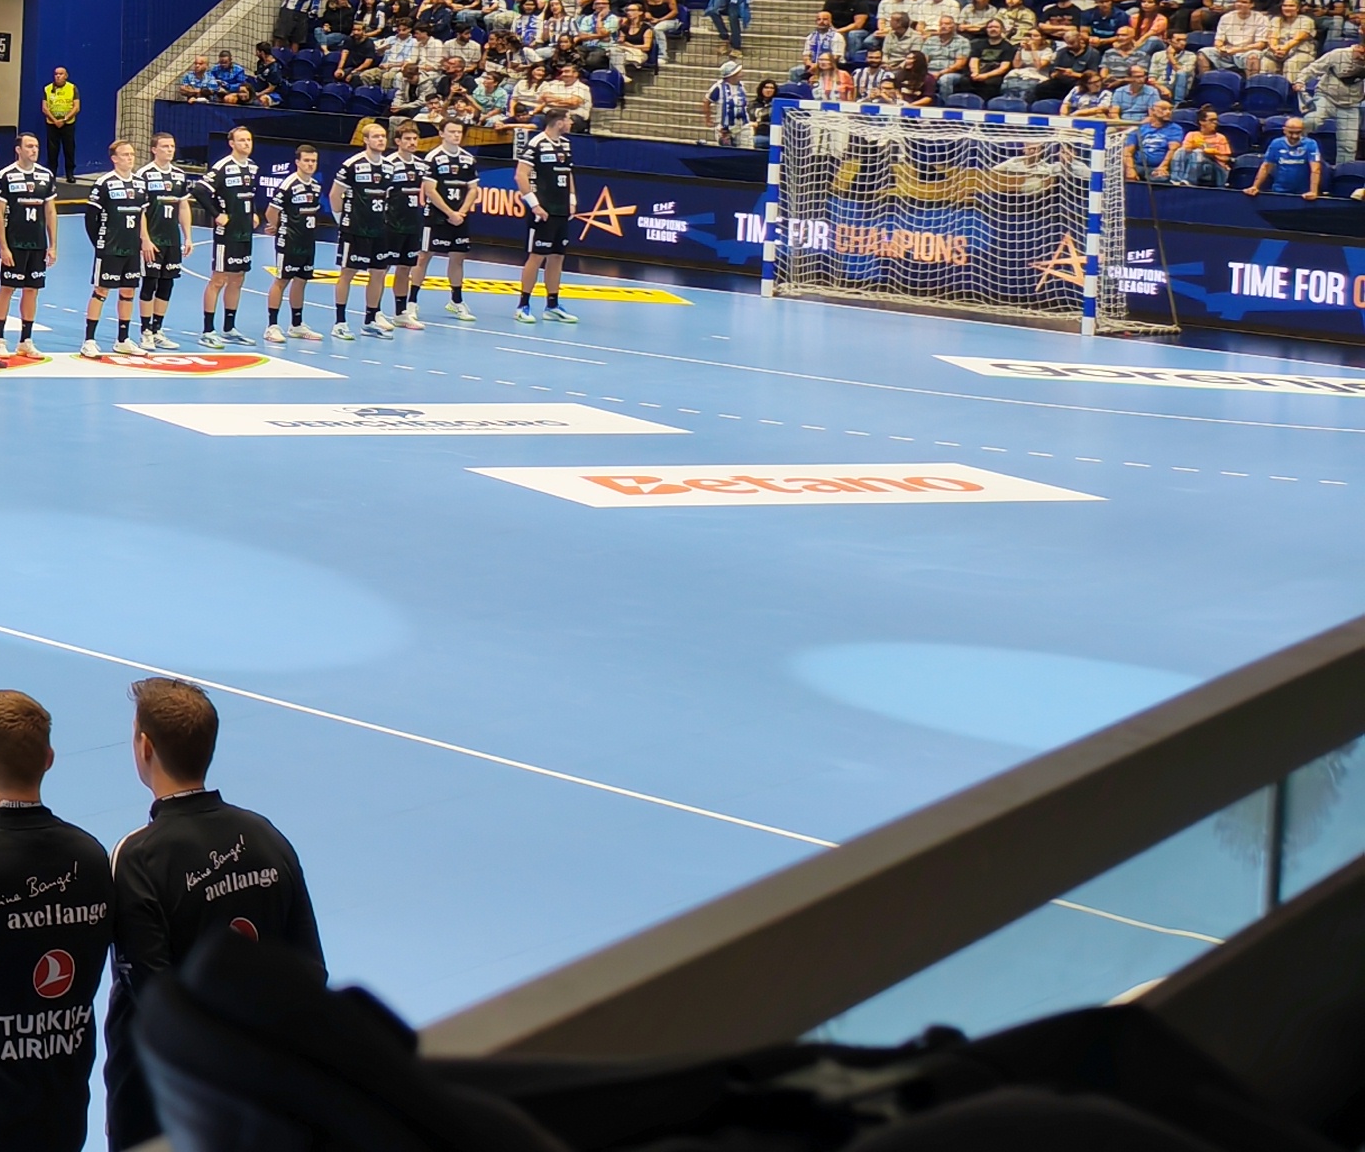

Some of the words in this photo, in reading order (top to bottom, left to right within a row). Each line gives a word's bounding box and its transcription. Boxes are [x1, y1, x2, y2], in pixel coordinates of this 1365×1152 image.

[0, 38, 6, 53] 5
[272, 163, 290, 174] EHF
[447, 188, 460, 201] 34
[372, 200, 383, 212] 25
[653, 202, 675, 214] EHF
[25, 207, 37, 222] 14
[126, 215, 136, 228] 15
[637, 217, 688, 232] CHAMPIONS
[646, 229, 678, 243] LEAGUE
[788, 219, 829, 251] FOR
[834, 223, 968, 265] CHAMPIONS
[1127, 249, 1155, 263] EHF
[1119, 280, 1158, 295] LEAGUE
[1228, 262, 1289, 299] TIME
[1294, 268, 1345, 306] FOR
[581, 474, 985, 496] Betano
[208, 834, 247, 870] Bange!
[26, 861, 79, 898] Bange!
